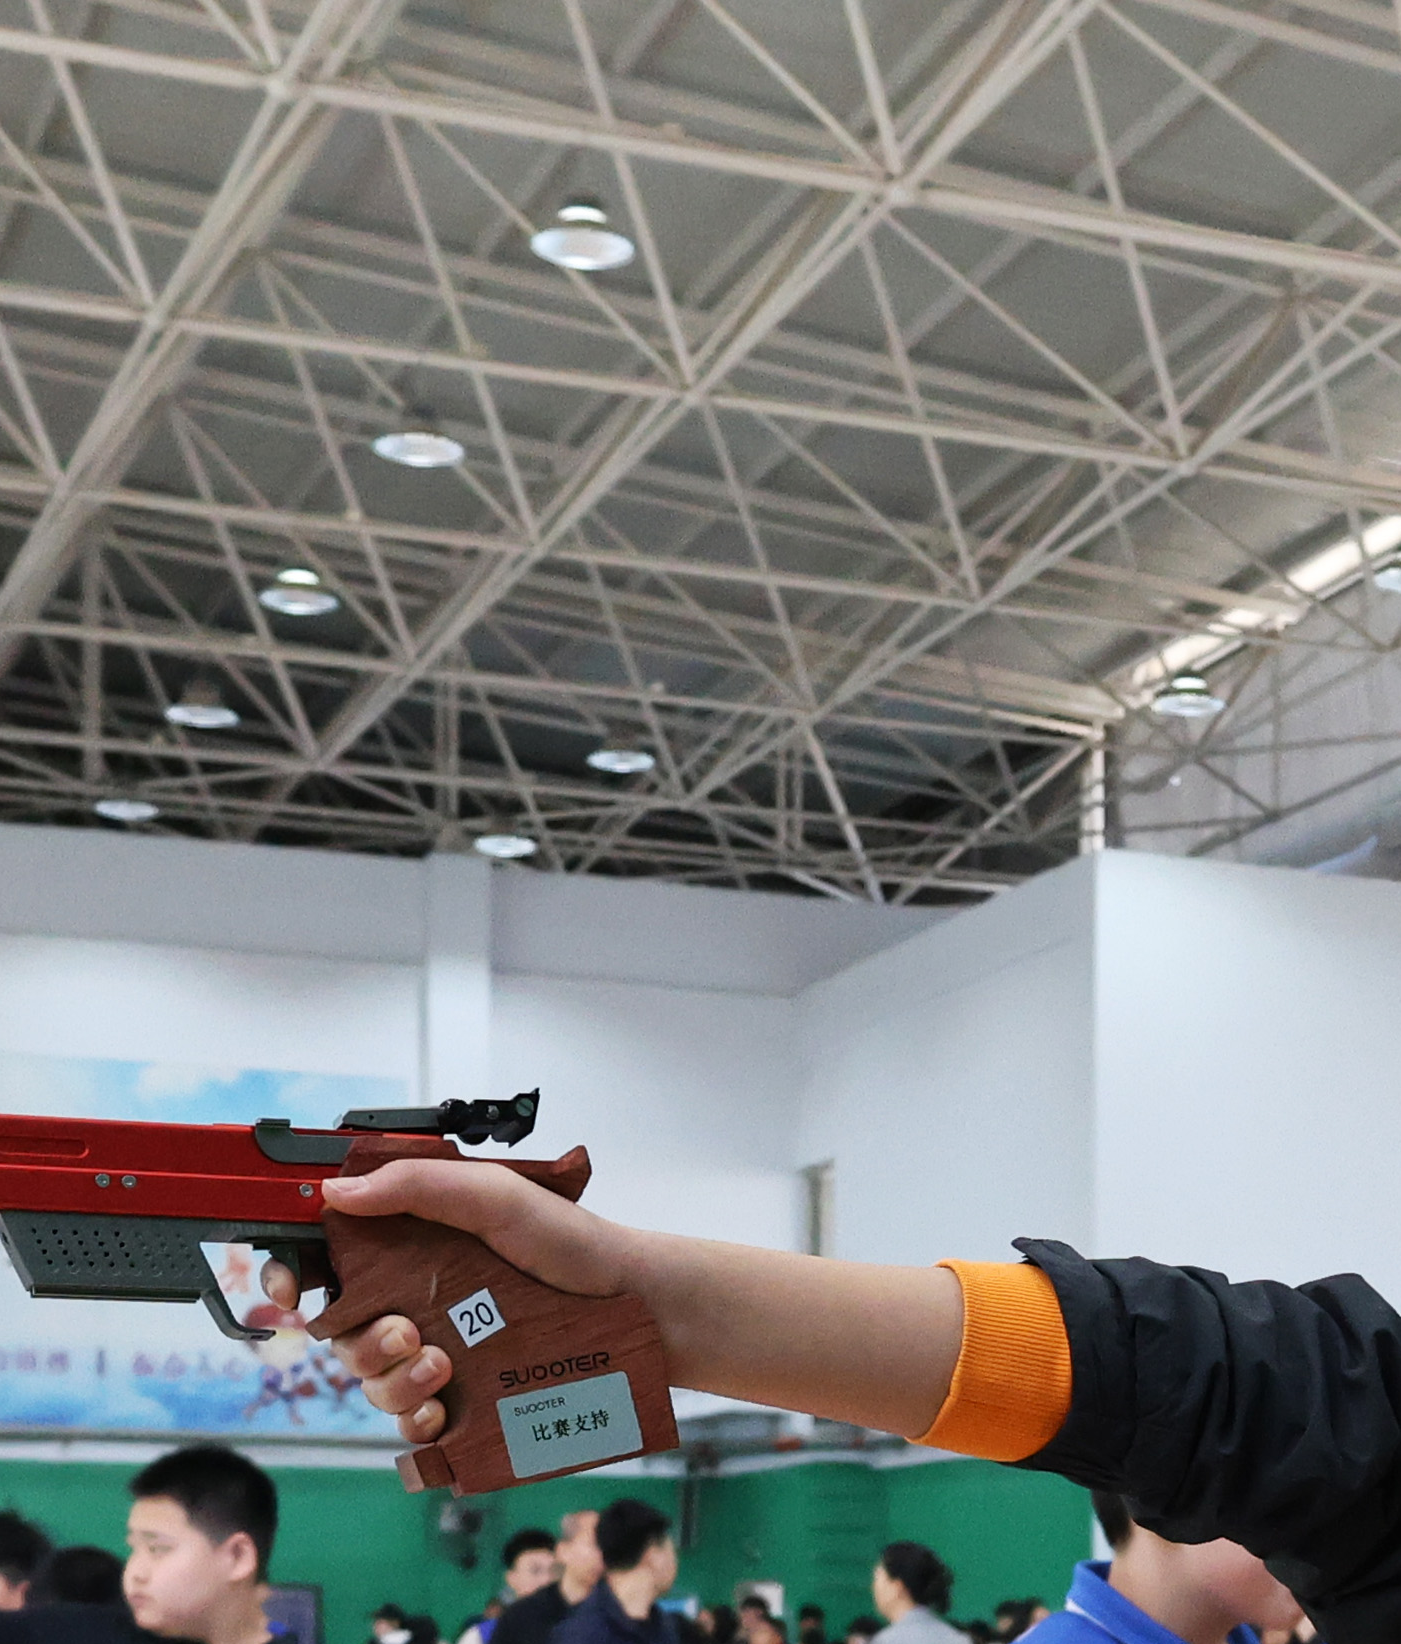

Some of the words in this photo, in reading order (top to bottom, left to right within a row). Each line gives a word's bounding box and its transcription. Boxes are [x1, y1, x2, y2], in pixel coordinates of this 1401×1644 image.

[459, 1302, 495, 1336] 20
[499, 1351, 610, 1389] SUOOTER
[514, 1397, 566, 1416] SUOOTER
[531, 1409, 610, 1442] 比赛支持
